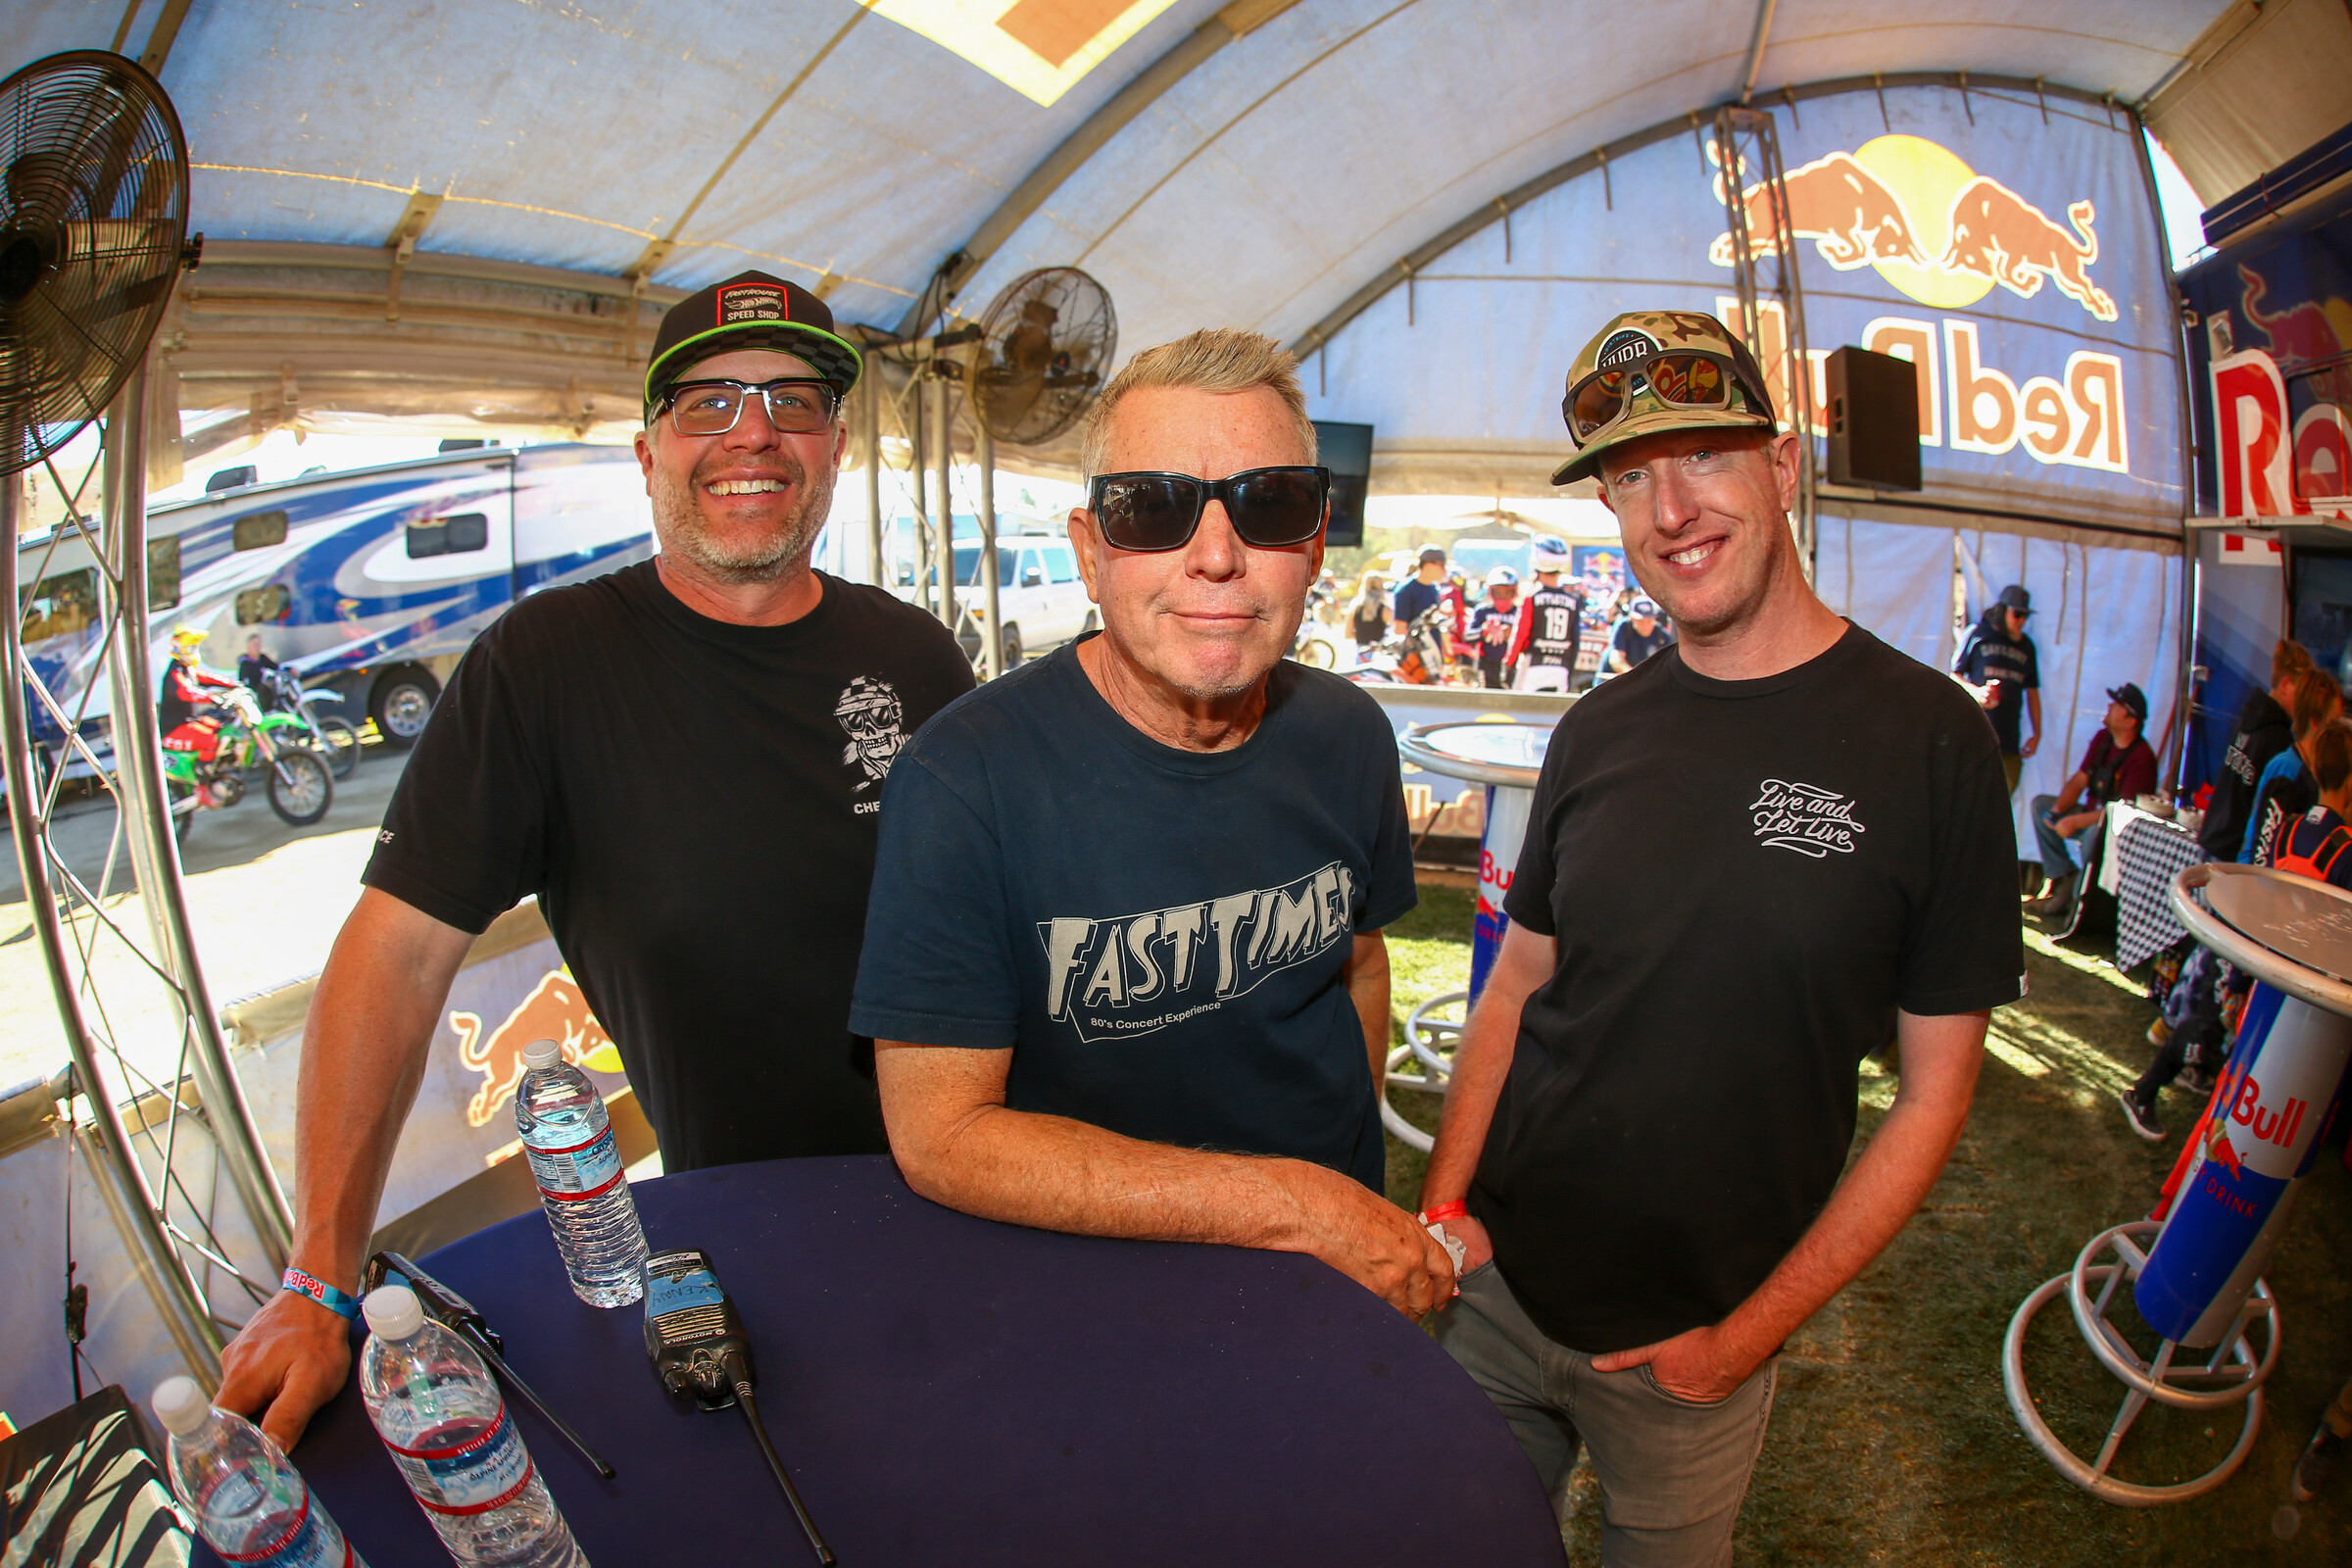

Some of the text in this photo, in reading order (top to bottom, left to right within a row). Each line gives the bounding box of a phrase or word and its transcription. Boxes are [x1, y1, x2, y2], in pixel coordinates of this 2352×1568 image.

[727, 310, 780, 321] SPEED SHOP
[1544, 607, 1569, 640] 19
[1749, 783, 1856, 819] Live and
[1753, 808, 1851, 845] Let Live
[1048, 866, 1356, 1022] FAST TIMES
[1090, 1000, 1222, 1030] 80's Concert Experience
[2230, 1073, 2308, 1149] Bull
[2206, 1177, 2258, 1218] DRINK
[653, 1285, 710, 1308] KENNY
[662, 1330, 714, 1346] MOTOROLA
